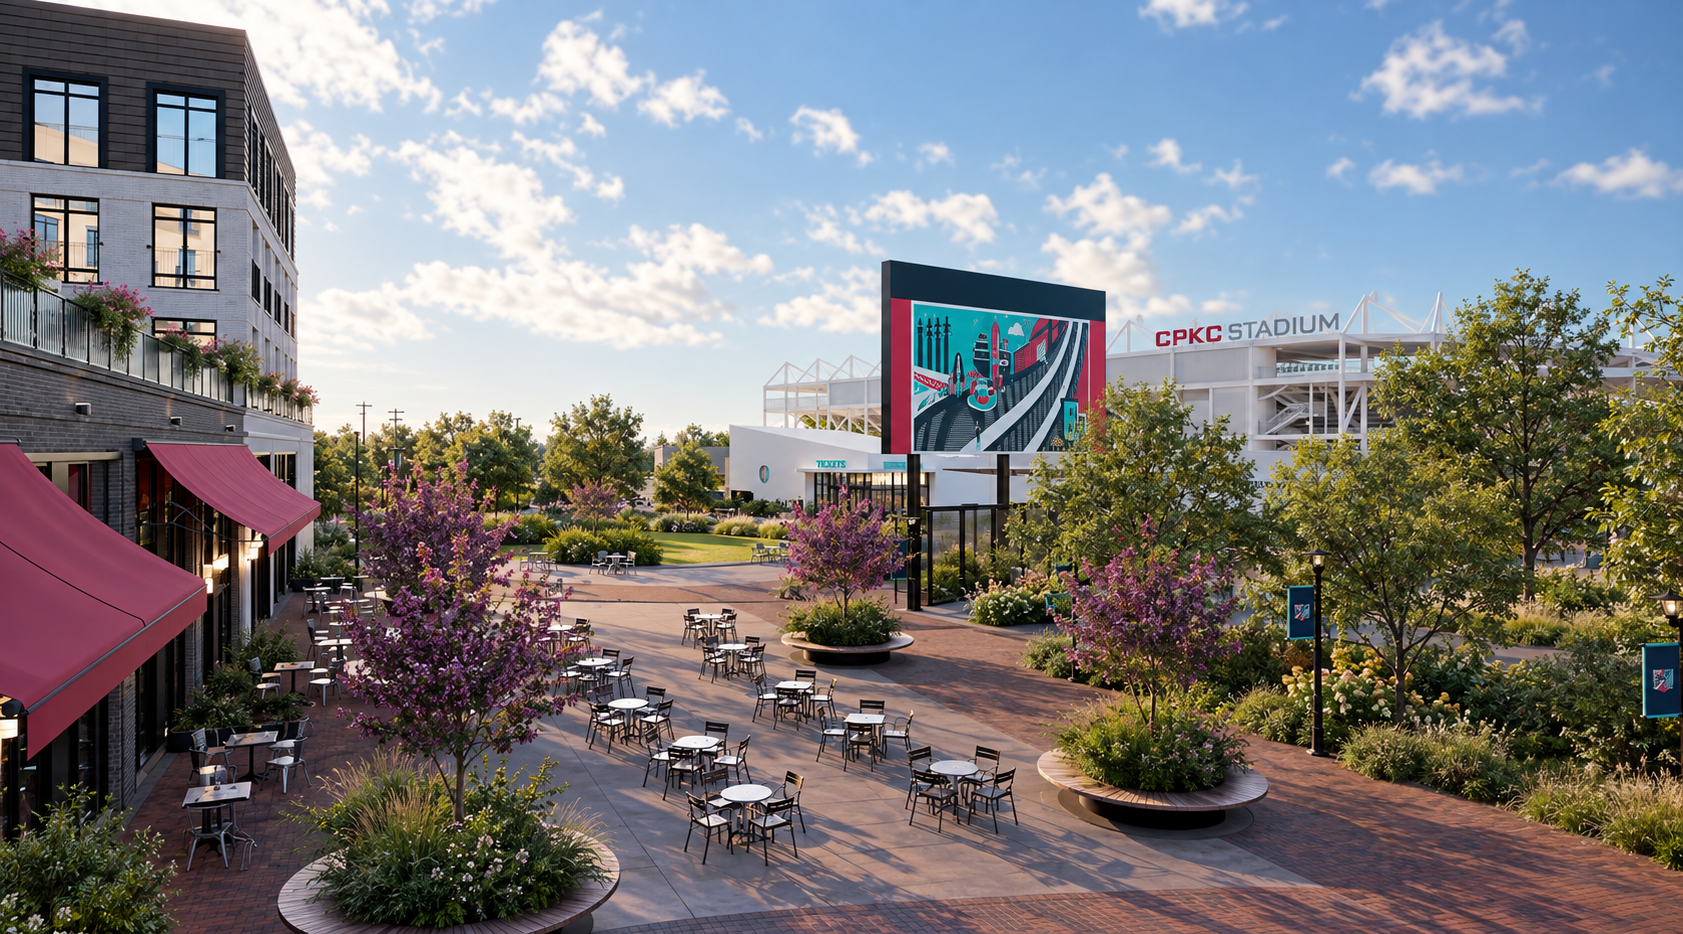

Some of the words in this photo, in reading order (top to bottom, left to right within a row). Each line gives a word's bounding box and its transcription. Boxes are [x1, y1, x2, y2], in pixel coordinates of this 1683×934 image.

[1155, 325, 1222, 347] CPKC
[1228, 313, 1340, 340] STADIUM
[816, 459, 846, 468] TICKETS
